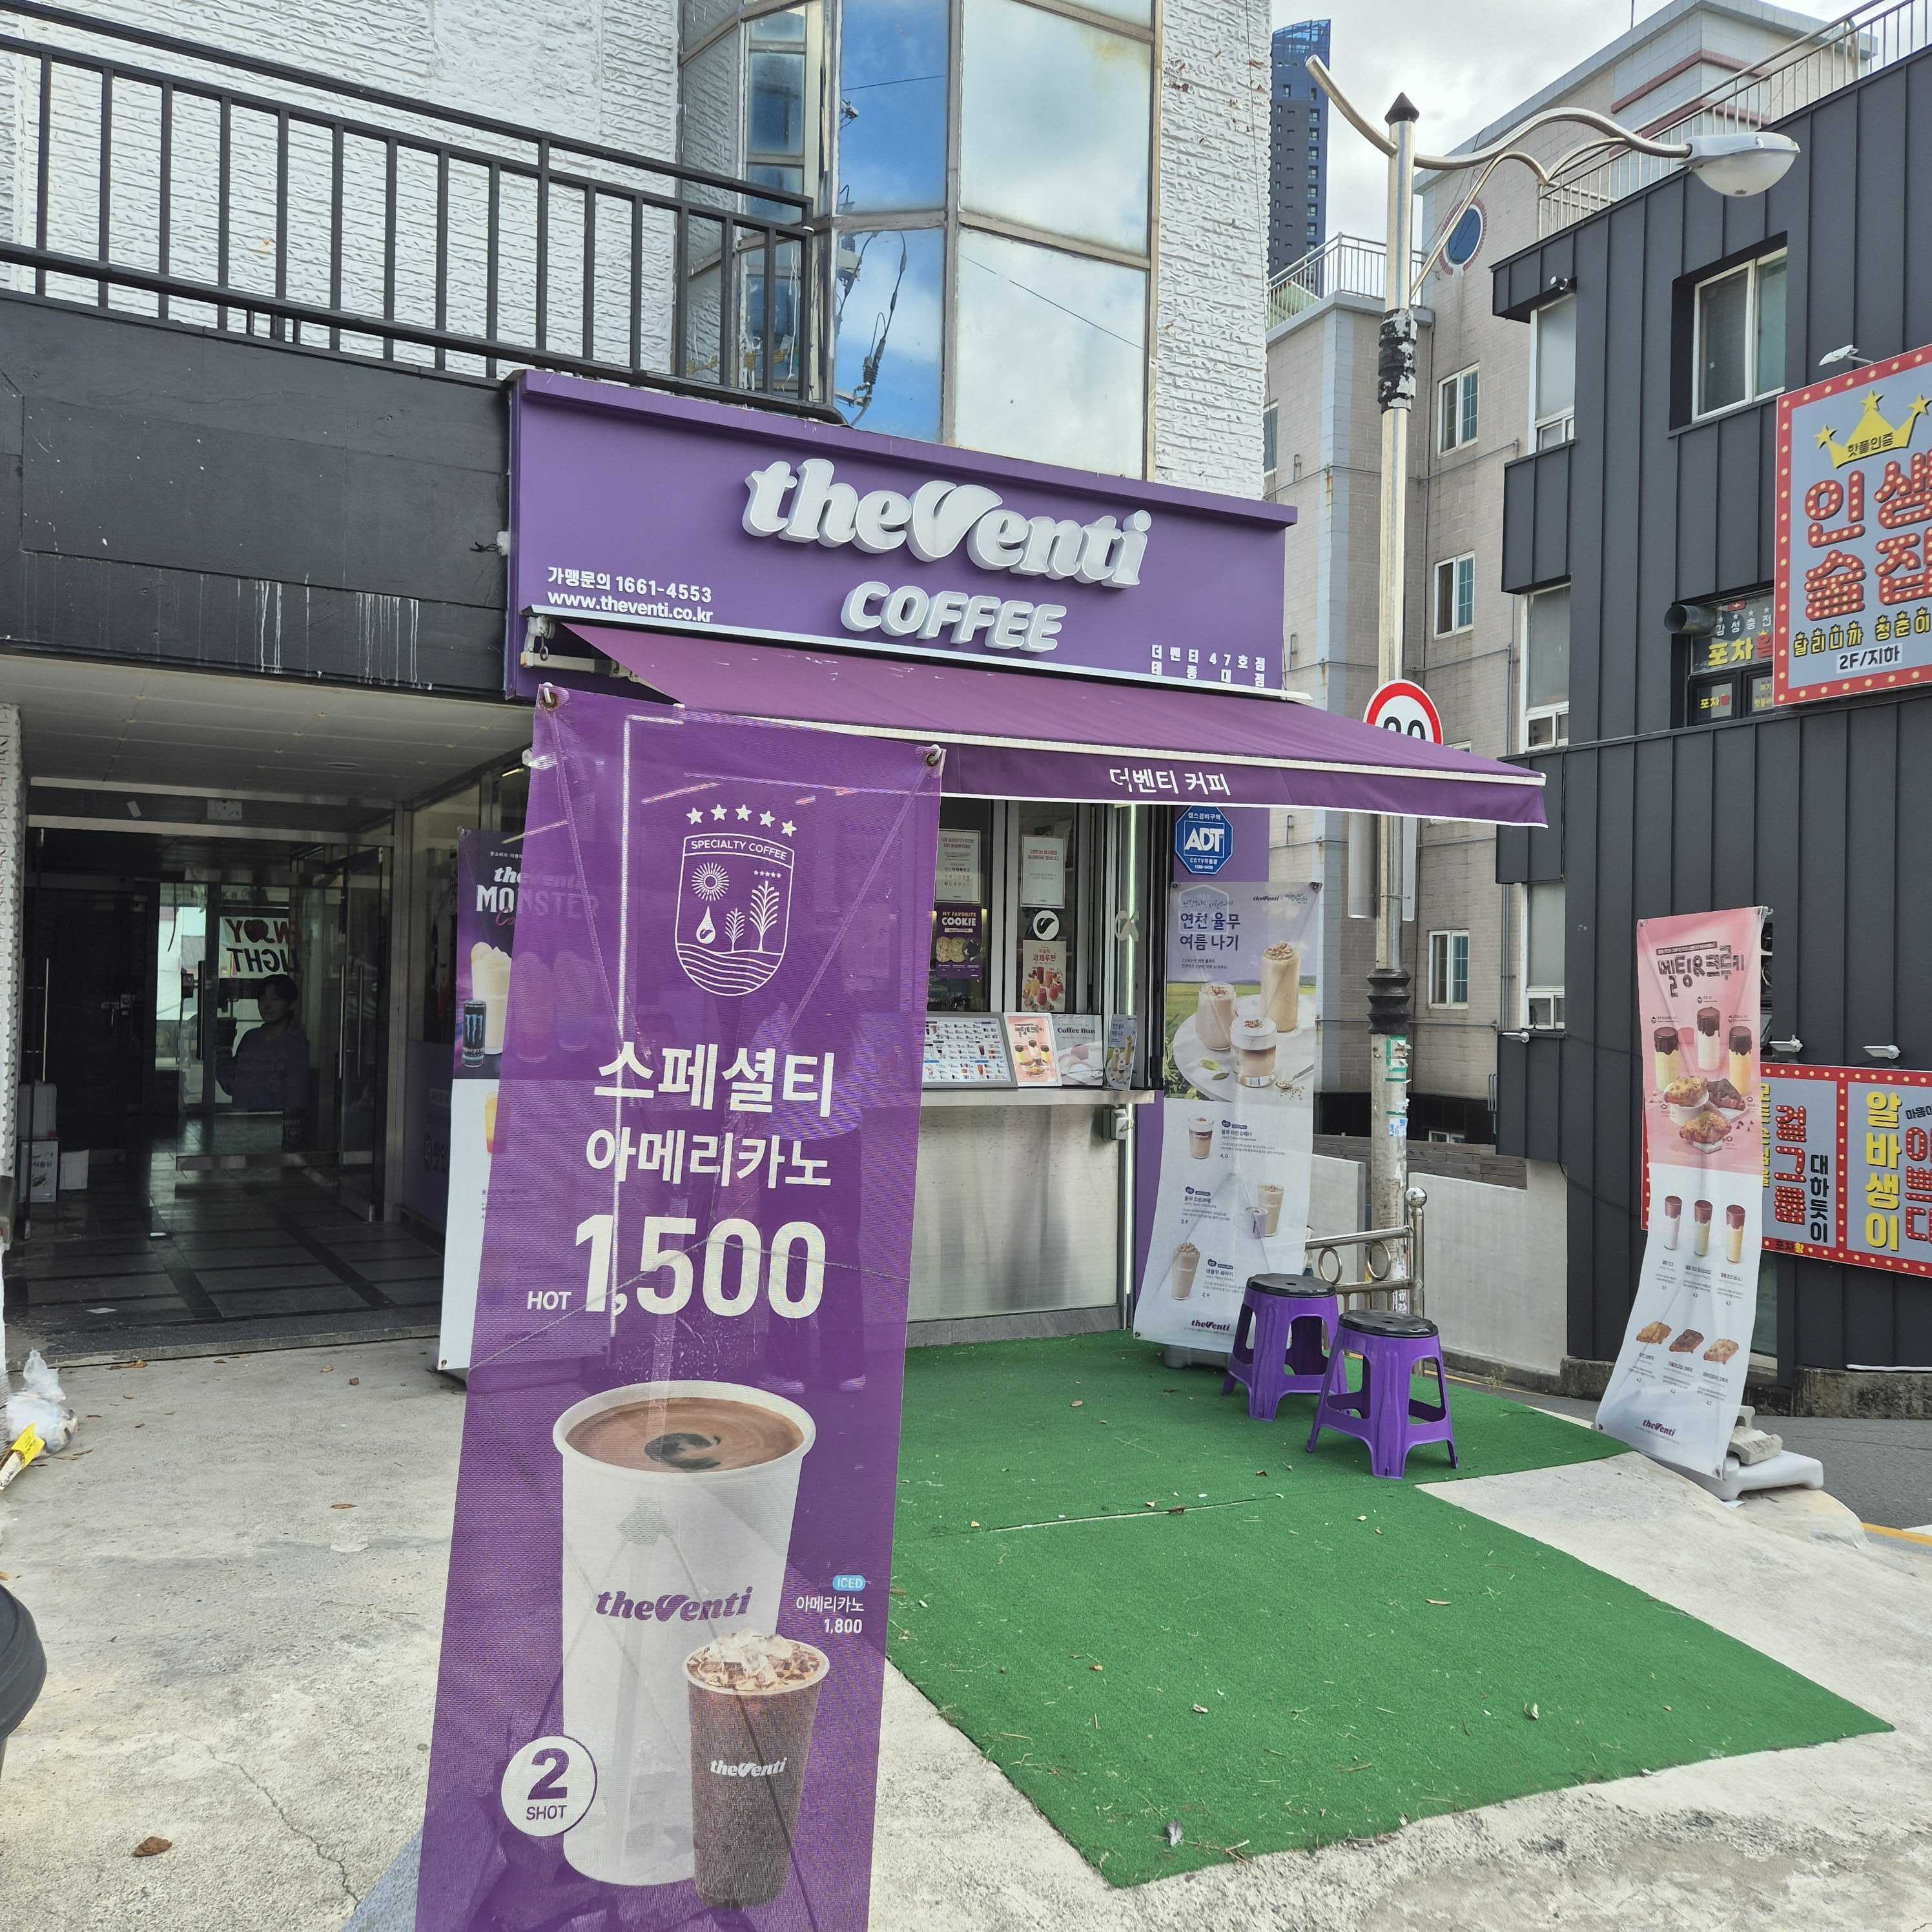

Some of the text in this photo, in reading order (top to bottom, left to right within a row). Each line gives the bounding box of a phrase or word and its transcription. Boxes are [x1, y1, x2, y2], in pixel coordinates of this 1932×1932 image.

[1847, 432, 1893, 458] 핫플인증
[742, 458, 1152, 589] theVenti
[548, 566, 712, 603] 가맹문의 1661-4553
[548, 591, 713, 622] www.theventi.co.kr
[840, 581, 1067, 653] COFFEE
[1793, 624, 1864, 657] 달리니까
[1839, 645, 1900, 670] 2F/지하
[1109, 767, 1231, 795] 더벤티 커피
[691, 839, 788, 861] SPECIALTY COFFEE
[1184, 827, 1224, 853] ADT
[941, 917, 976, 926] COOKIE
[1180, 912, 1240, 930] 연천 율무
[1180, 934, 1239, 951] 여름 나기
[593, 1042, 835, 1118] 스페셜티
[586, 1127, 832, 1189] 아메리카노
[1774, 1105, 1807, 1226] 걸그룹
[1865, 1091, 1903, 1252] 알바생이
[1809, 1154, 1829, 1243] 대하듯이
[575, 1215, 827, 1319] 1,500
[527, 1291, 571, 1310] HOT
[1191, 1319, 1230, 1331] theVenti
[1642, 1419, 1676, 1437] theVenti
[837, 1577, 863, 1588] ICED
[595, 1586, 754, 1622] theVenti
[796, 1595, 865, 1613] 아메리카노
[823, 1618, 863, 1635] 1,800
[527, 1748, 569, 1800] 2
[710, 1757, 788, 1778] theVenti
[526, 1805, 568, 1820] SHOT
